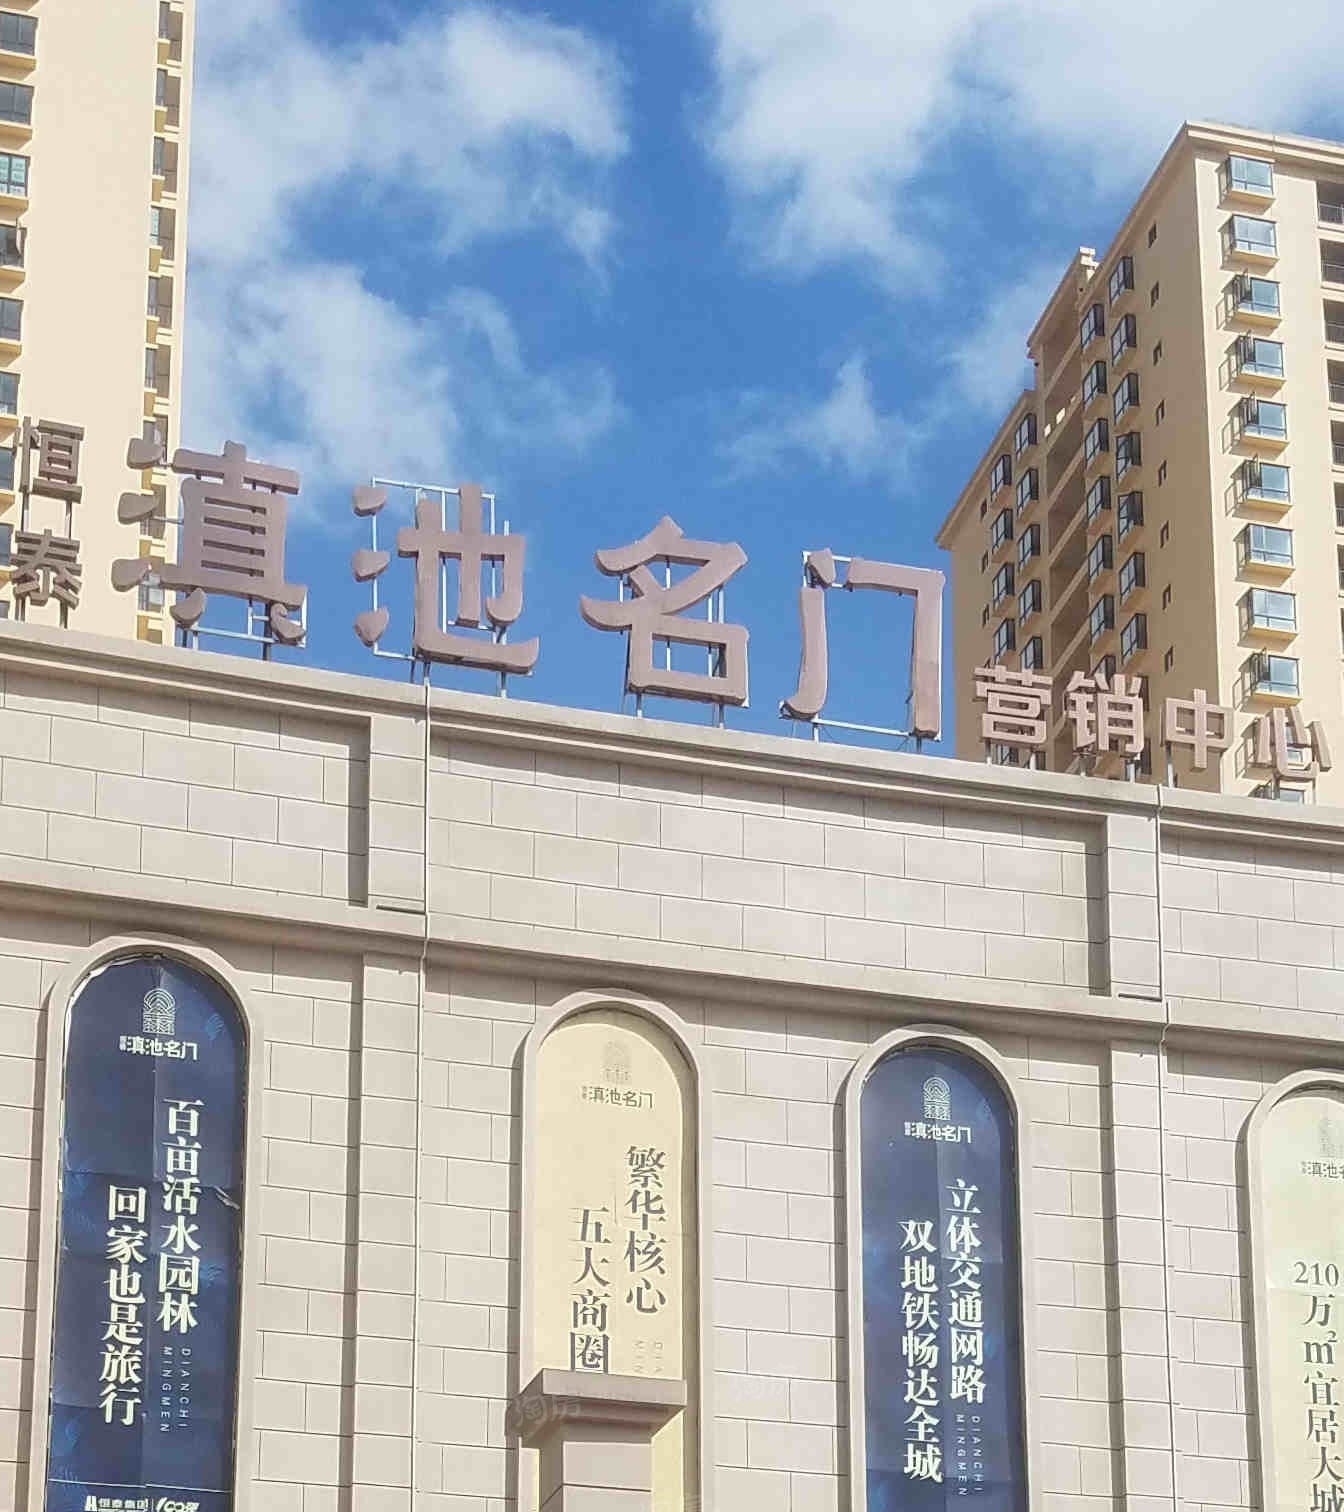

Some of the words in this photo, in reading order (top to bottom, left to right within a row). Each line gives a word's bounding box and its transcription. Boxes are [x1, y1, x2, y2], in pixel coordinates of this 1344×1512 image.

[12, 416, 83, 607] 恒泰
[111, 438, 944, 741] 滇池名门
[973, 665, 1334, 781] 营销中心
[156, 1098, 205, 1335] 百亩活水园林
[570, 1205, 612, 1373] 五大商圈
[624, 1145, 666, 1316] 繁华核心
[945, 1178, 986, 1406] 立体交通网路
[100, 1185, 148, 1427] 回家也是旅行
[160, 1346, 173, 1434] MINGMEN
[179, 1347, 192, 1430] DIANCHI
[898, 1219, 944, 1482] 双地铁畅达全城
[971, 1415, 984, 1495] DIANCHI
